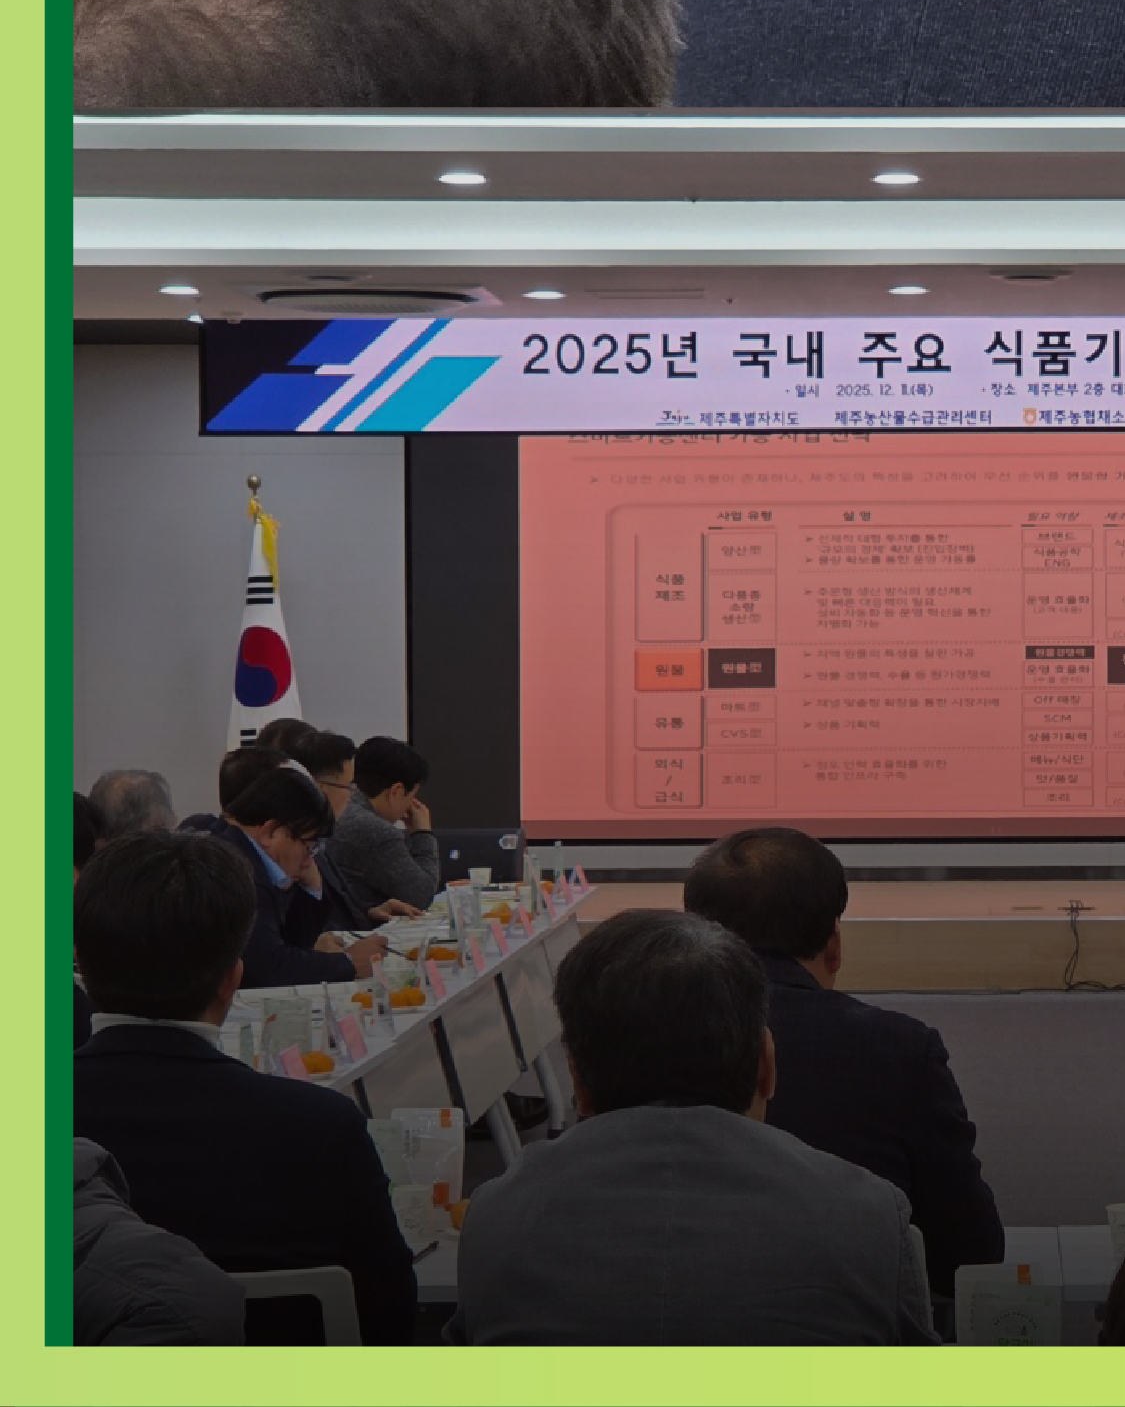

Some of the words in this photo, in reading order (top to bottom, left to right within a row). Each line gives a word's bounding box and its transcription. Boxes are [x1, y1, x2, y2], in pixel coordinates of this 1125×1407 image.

[522, 330, 698, 379] 2025년
[732, 330, 824, 379] 국내
[858, 330, 951, 379] 주요
[991, 383, 1016, 397] 장소
[1028, 383, 1078, 397] 제주본부
[1084, 383, 1105, 397] 2층
[700, 409, 799, 426] 제주특별자치도
[835, 409, 992, 426] 제주농산물수급관리센터
